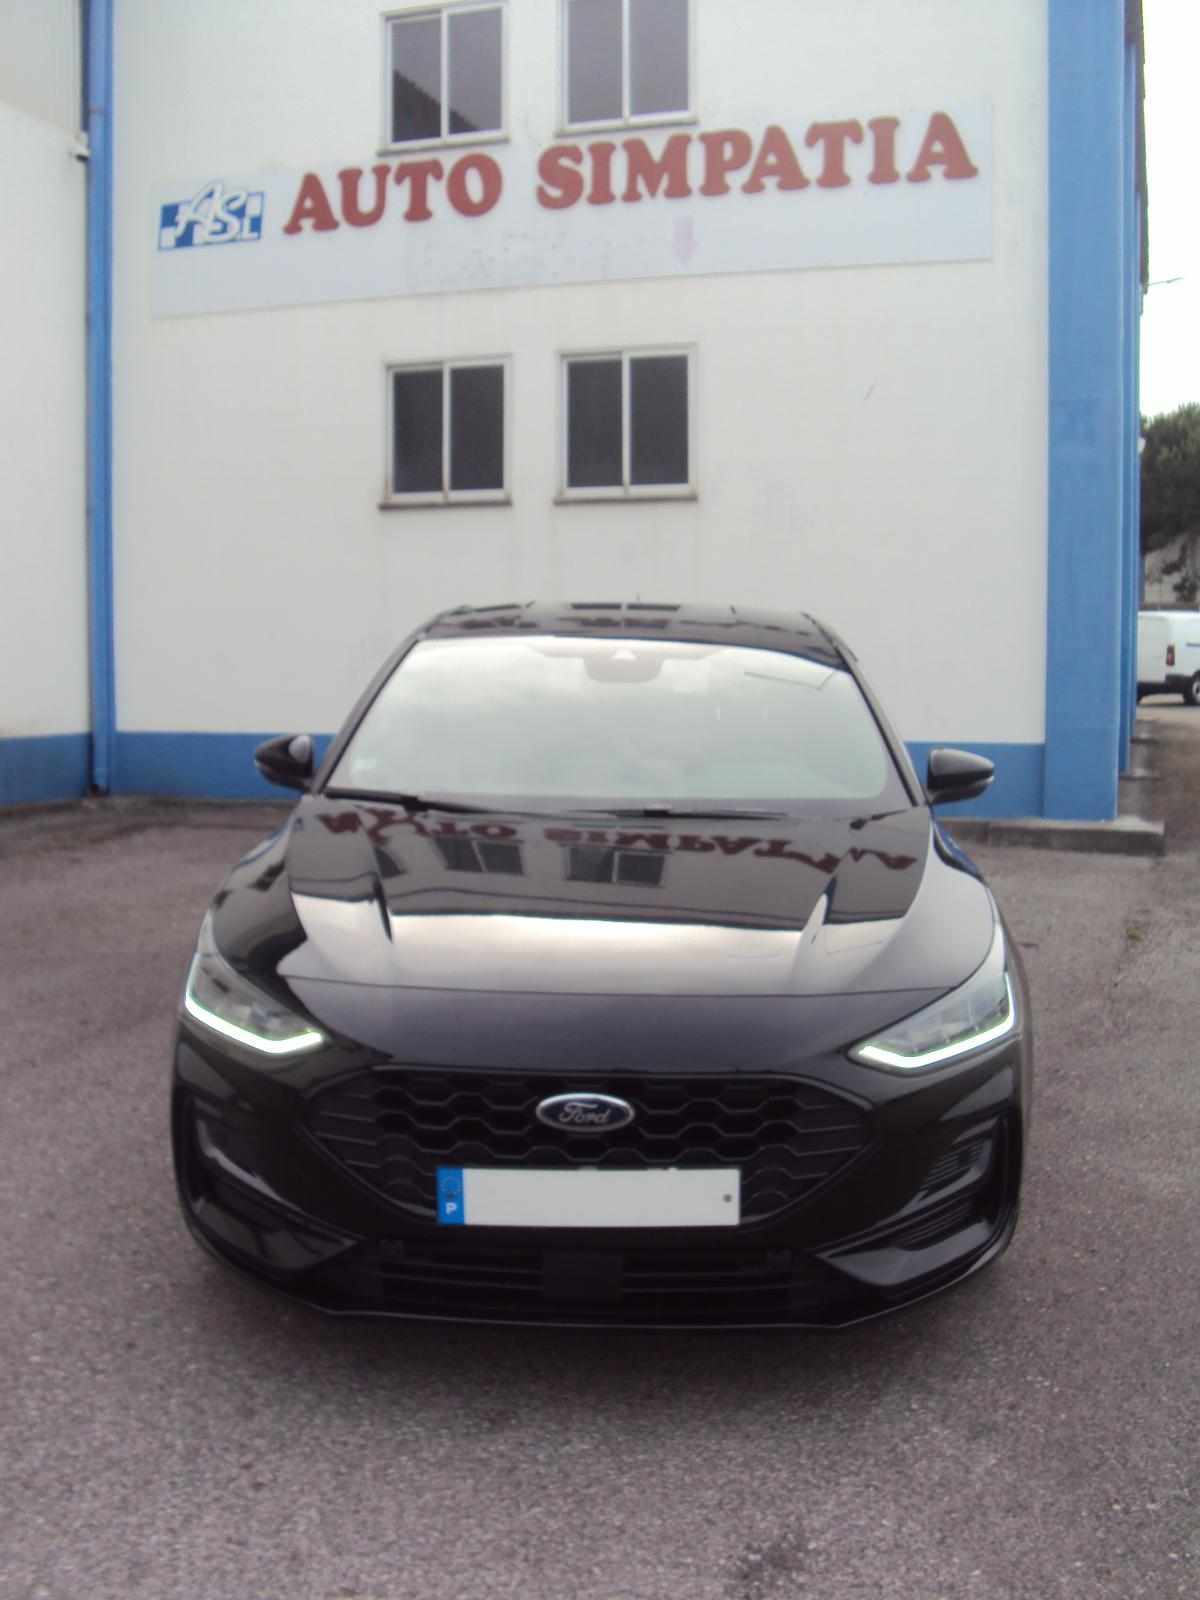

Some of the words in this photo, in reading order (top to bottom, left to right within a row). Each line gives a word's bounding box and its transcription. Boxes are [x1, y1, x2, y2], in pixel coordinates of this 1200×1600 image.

[283, 152, 503, 234] AUTO
[536, 111, 978, 210] SIMPATIA
[560, 1102, 611, 1123] Ford
[446, 1202, 457, 1215] P
